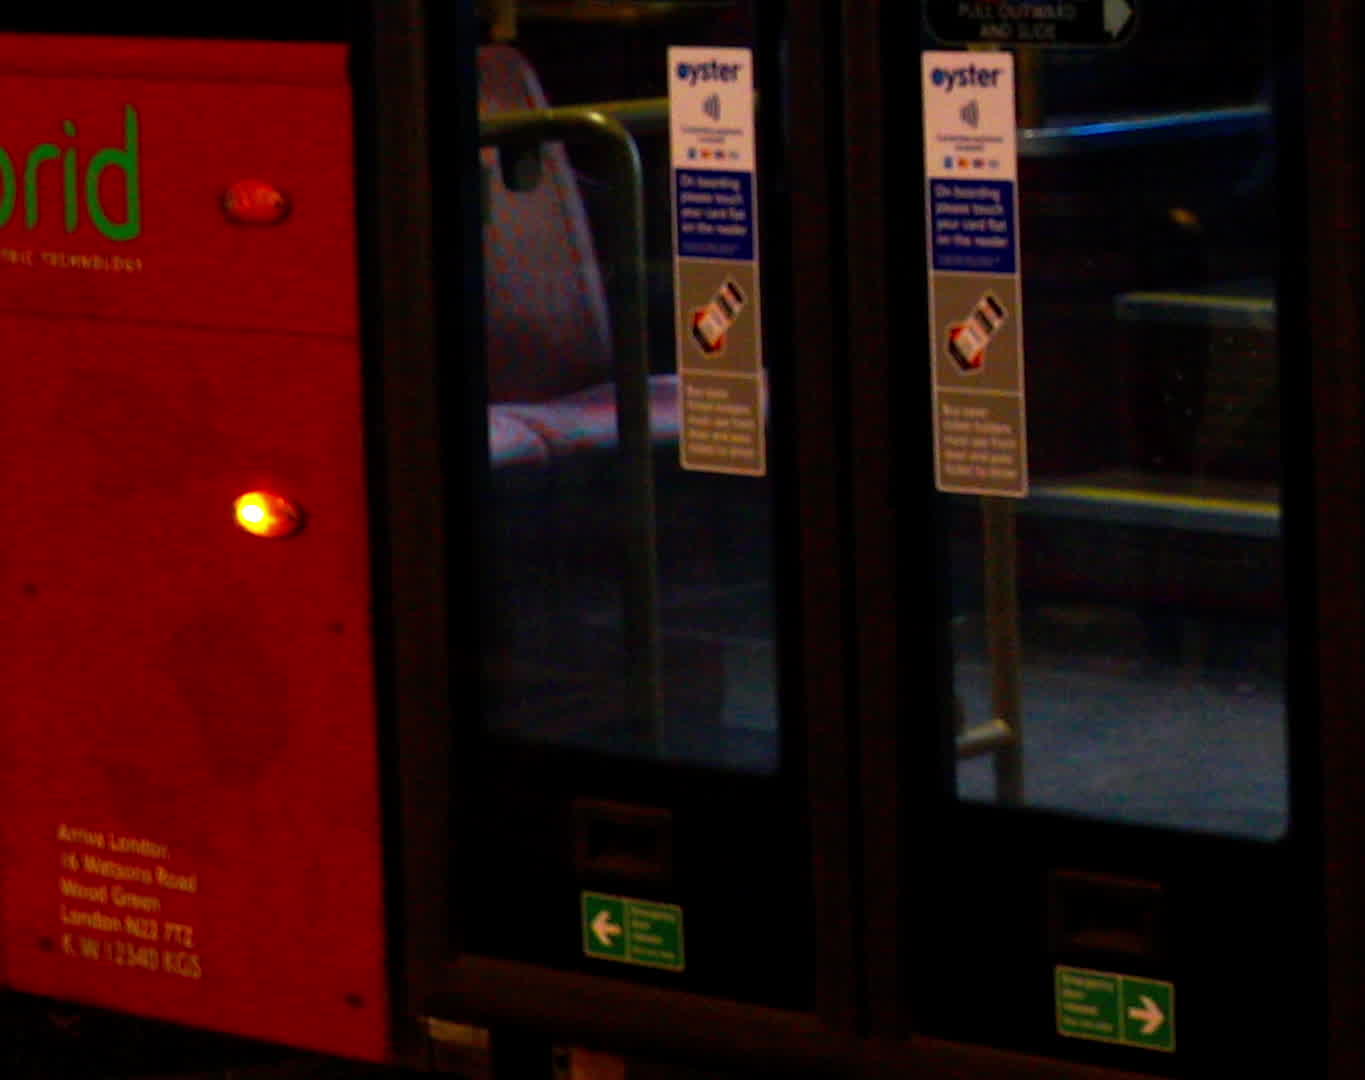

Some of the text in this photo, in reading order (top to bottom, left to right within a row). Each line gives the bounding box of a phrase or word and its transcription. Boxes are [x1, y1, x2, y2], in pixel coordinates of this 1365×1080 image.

[677, 60, 739, 87] oyster
[931, 64, 999, 92] oyster
[155, 865, 197, 894] Road
[60, 877, 161, 913] Wood Green
[60, 904, 121, 932] London
